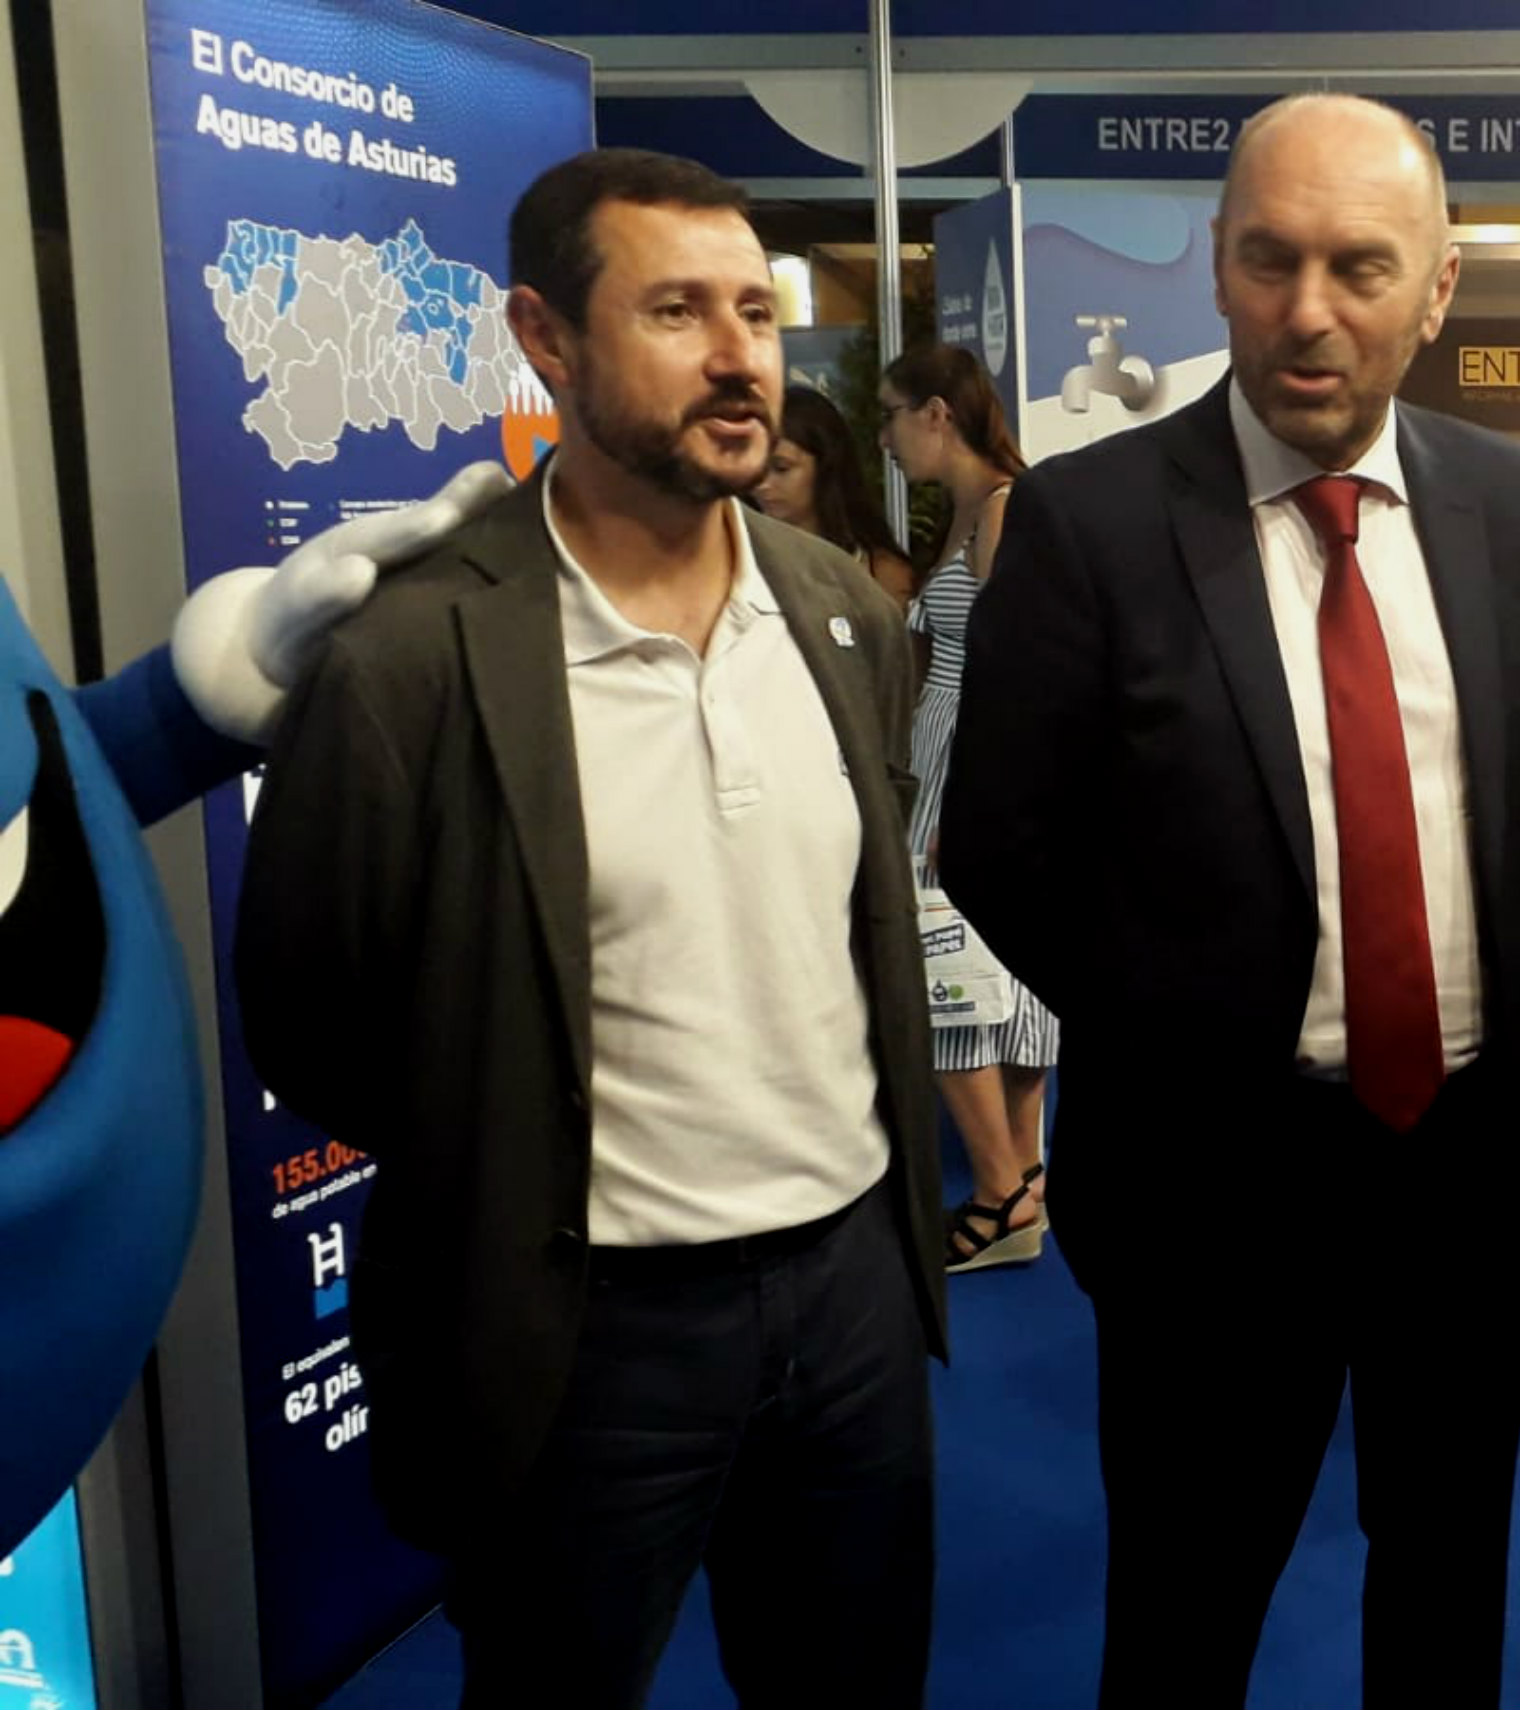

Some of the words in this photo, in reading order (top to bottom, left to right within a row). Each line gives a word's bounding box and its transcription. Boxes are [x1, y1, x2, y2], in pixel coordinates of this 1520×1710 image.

[191, 28, 223, 76] El
[231, 41, 376, 113] Consorcio
[380, 82, 415, 122] de
[197, 94, 298, 153] Aguas
[303, 121, 342, 163] de
[348, 130, 457, 186] Asturias
[1099, 118, 1231, 151] ENTRE2
[1448, 119, 1469, 151] E
[284, 1382, 319, 1424] 62
